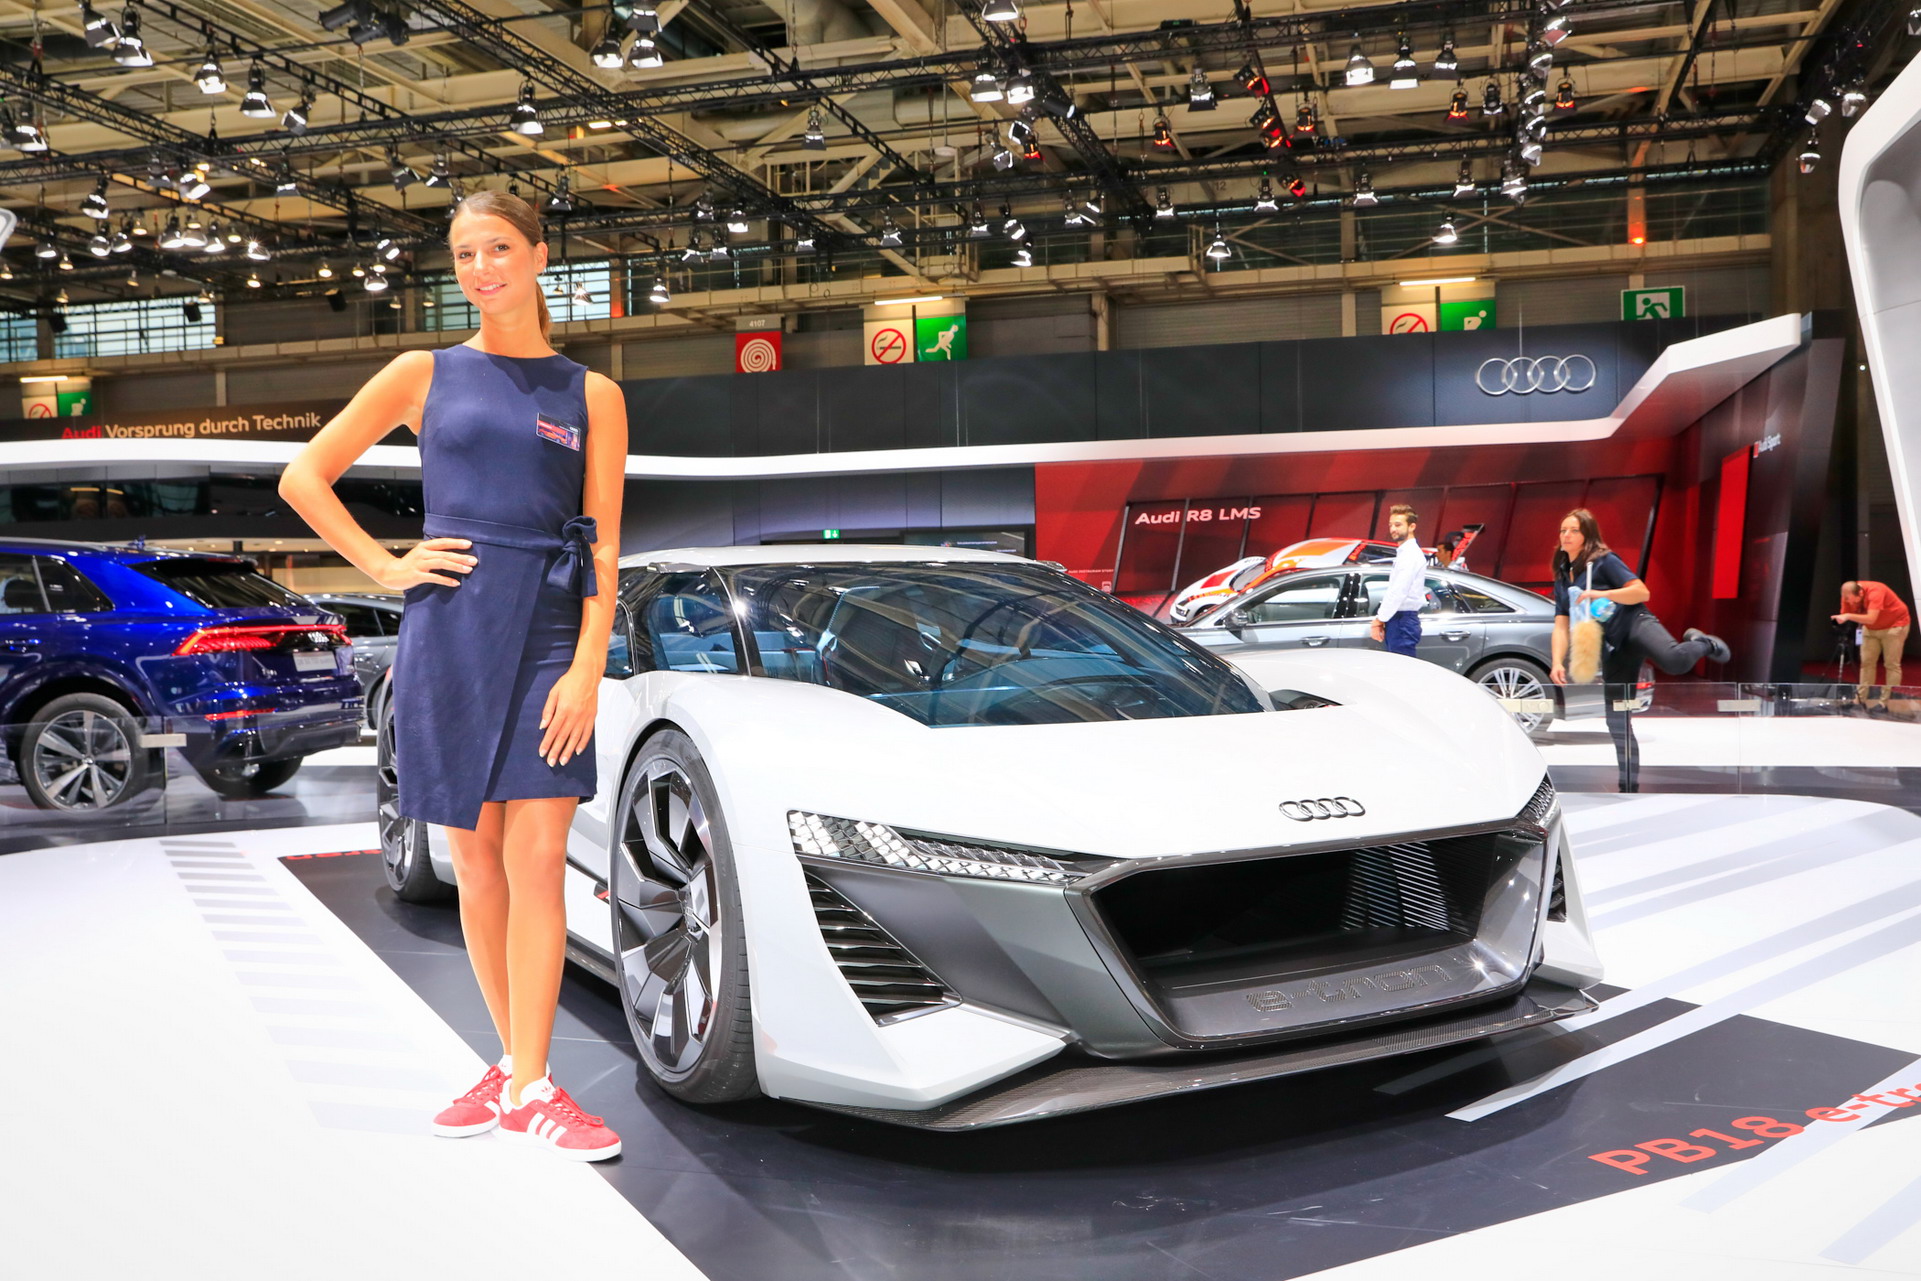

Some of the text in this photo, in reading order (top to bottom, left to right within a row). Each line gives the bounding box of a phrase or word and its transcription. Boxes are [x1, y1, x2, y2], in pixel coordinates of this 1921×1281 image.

[749, 319, 766, 327] 4107
[61, 412, 322, 439] Audi Vorsprung durch Technik
[1135, 506, 1262, 525] Audi R8 LMS
[1587, 1082, 1921, 1175] PB18 e-tr
